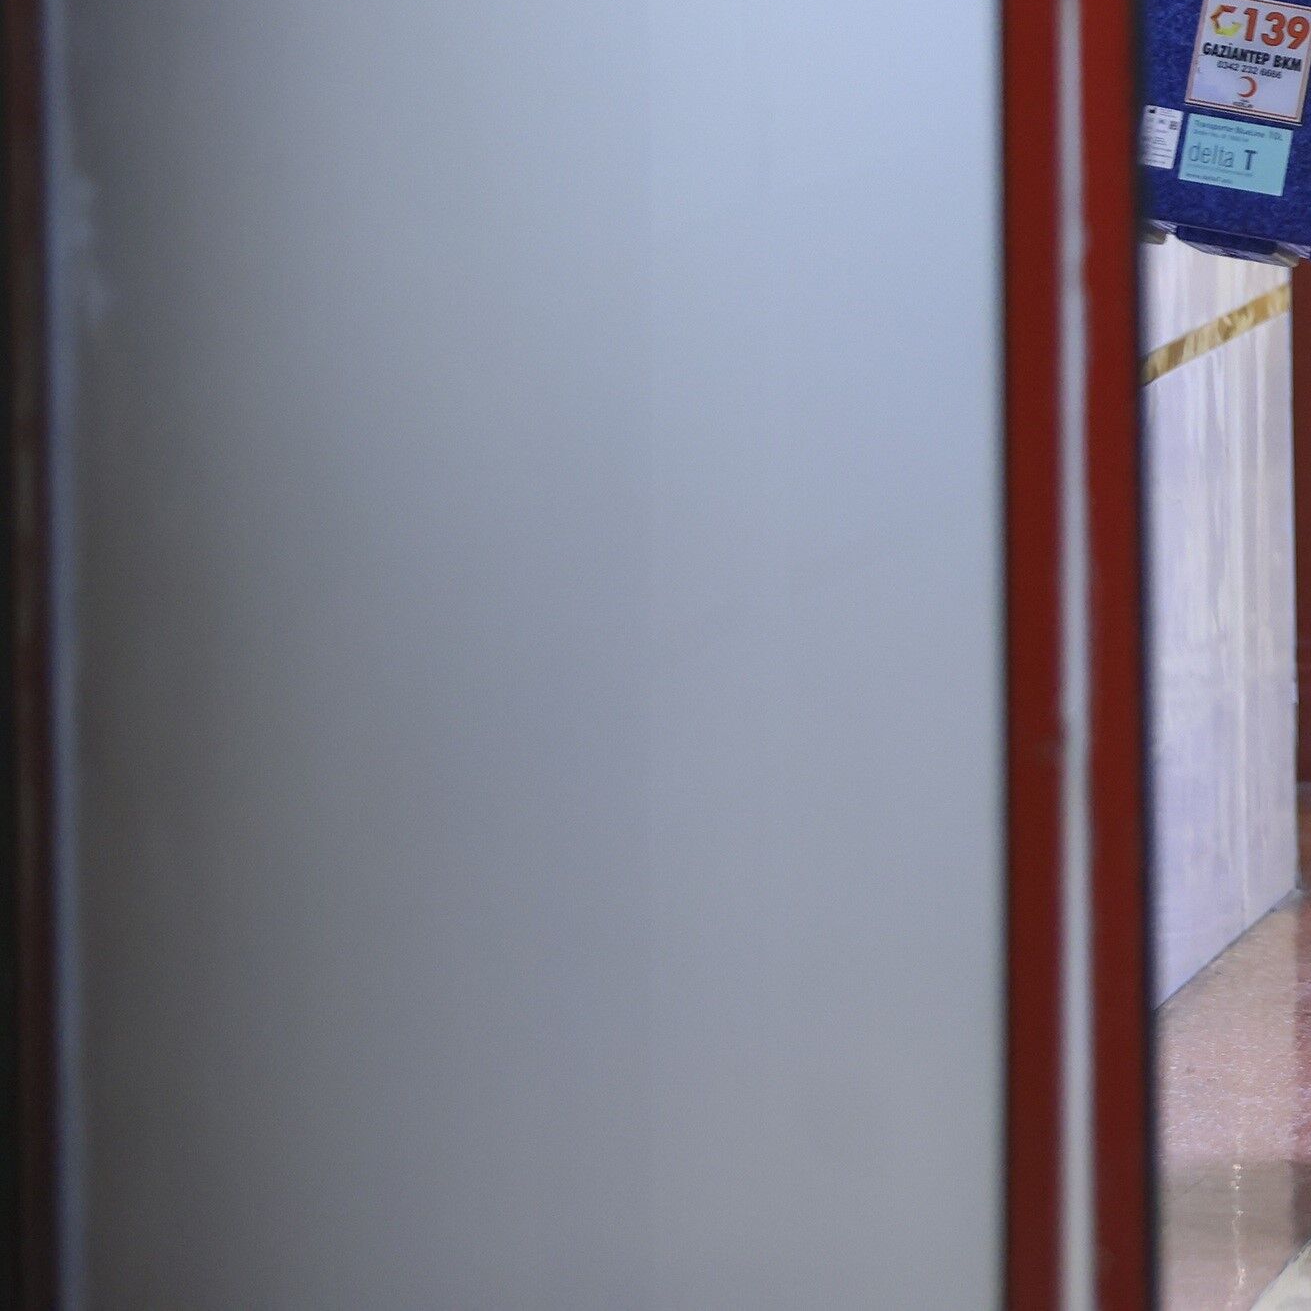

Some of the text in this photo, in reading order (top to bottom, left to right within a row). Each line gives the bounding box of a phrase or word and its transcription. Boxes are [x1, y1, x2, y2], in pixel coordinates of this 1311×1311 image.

[1242, 7, 1310, 50] 139
[1202, 42, 1302, 72] GAZİANTEP BKM
[1188, 141, 1235, 168] delta
[1244, 149, 1258, 171] T
